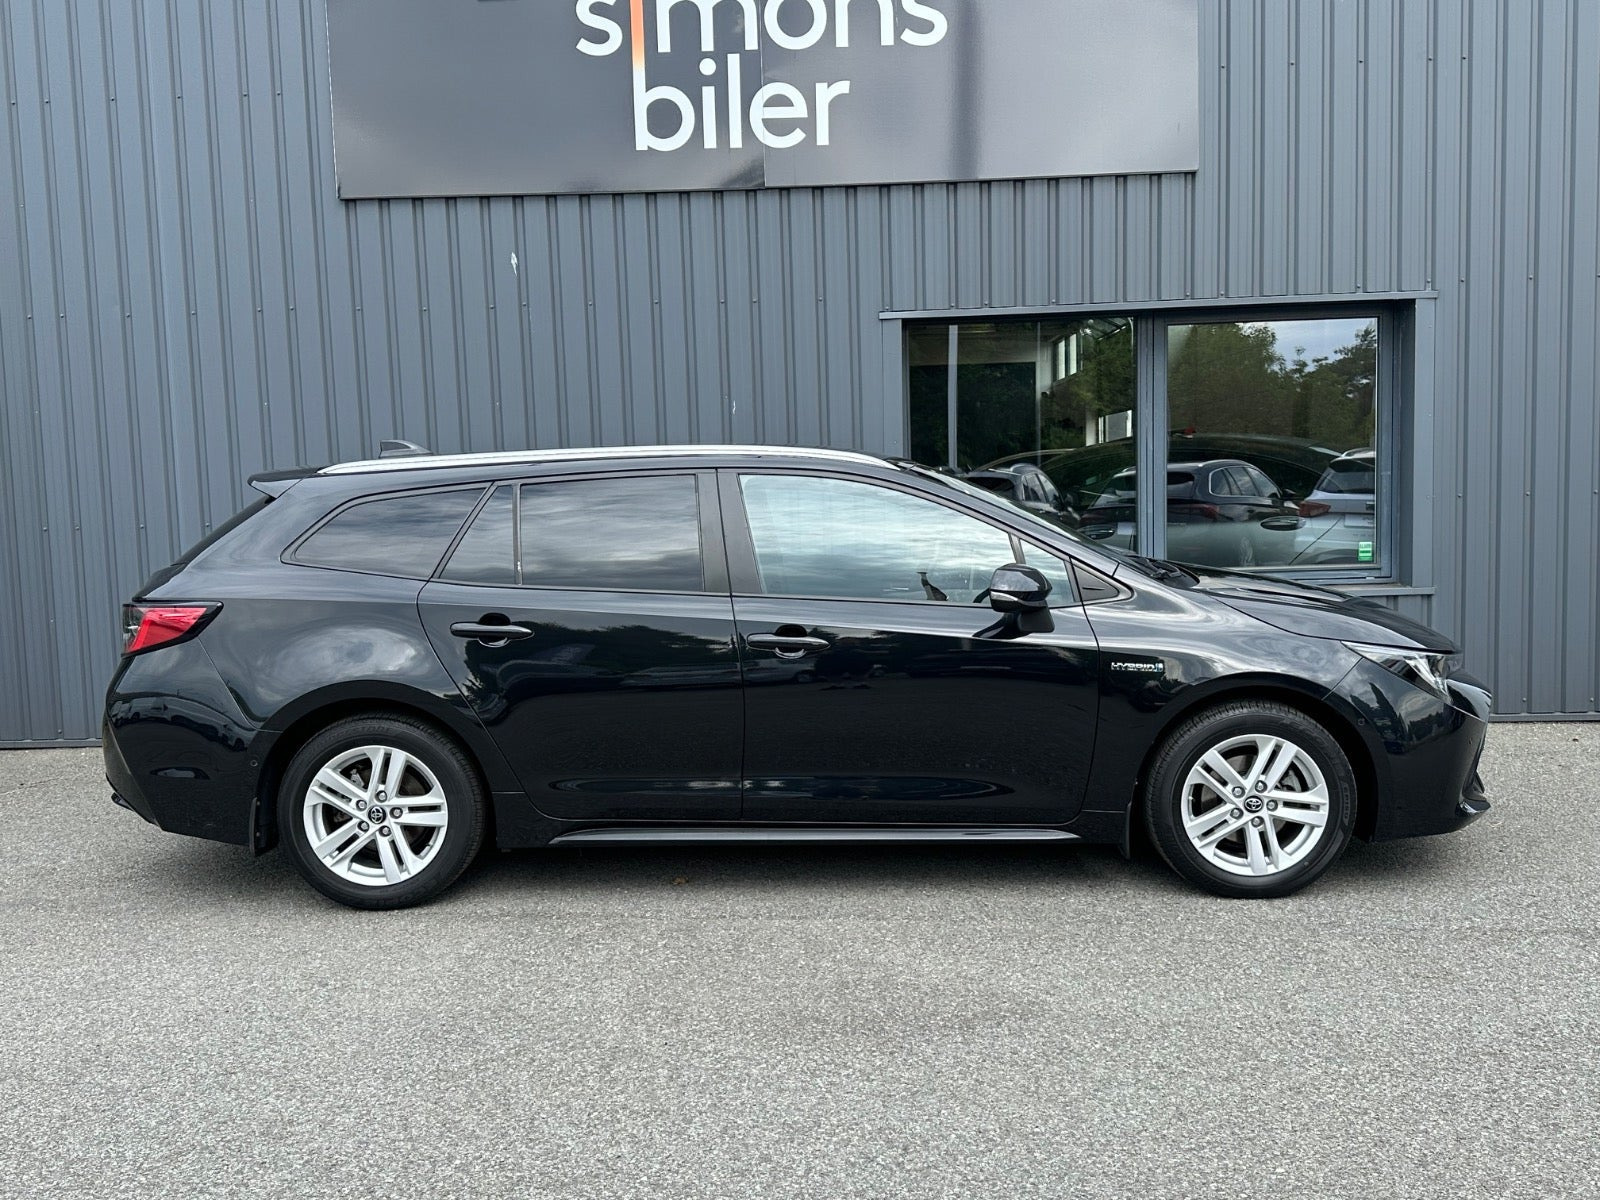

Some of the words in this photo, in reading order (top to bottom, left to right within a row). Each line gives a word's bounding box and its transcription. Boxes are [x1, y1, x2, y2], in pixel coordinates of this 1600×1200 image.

[575, 0, 948, 57] simons
[632, 53, 851, 152] biler
[1111, 661, 1155, 672] HYBRID
